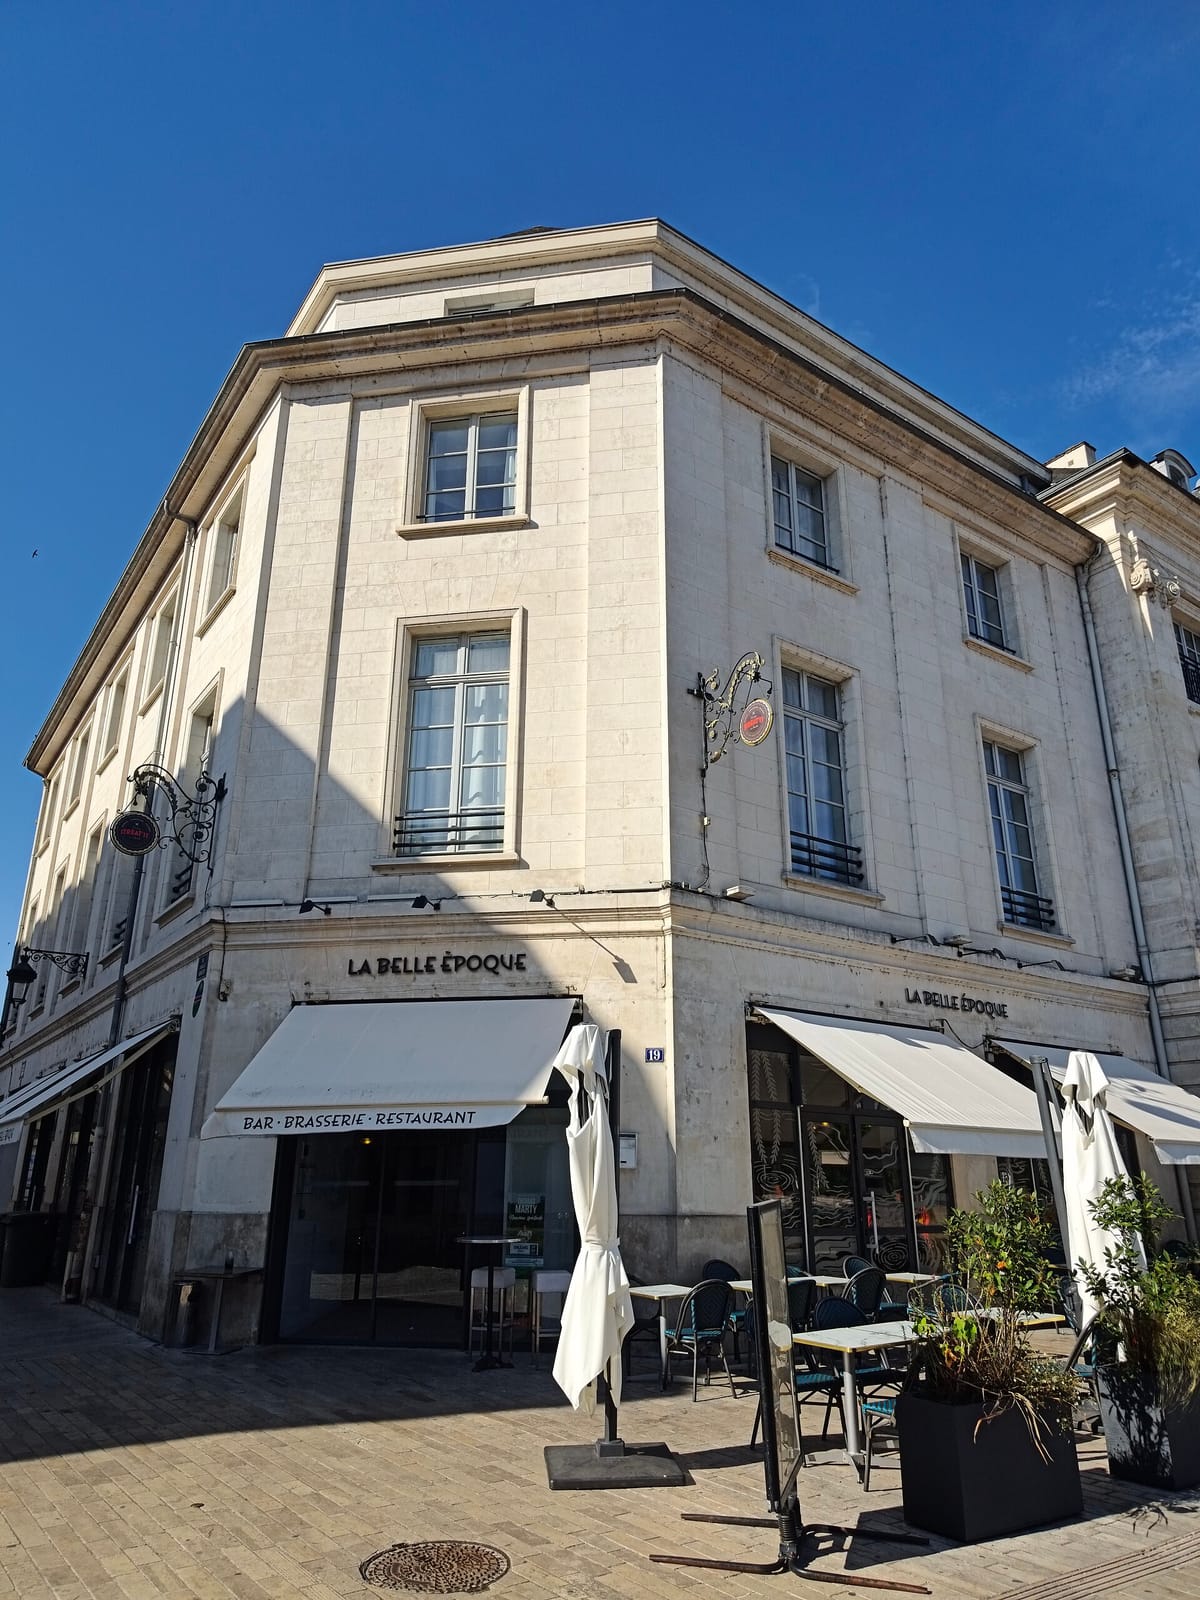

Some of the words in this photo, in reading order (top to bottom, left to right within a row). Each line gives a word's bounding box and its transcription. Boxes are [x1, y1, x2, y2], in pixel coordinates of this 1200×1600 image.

[348, 959, 372, 975] LA
[377, 956, 437, 974] BELLE
[440, 951, 527, 975] ÉPOQUE
[904, 987, 922, 1004] LA
[922, 990, 960, 1010] BELLE
[961, 993, 1009, 1019] ÉPOQUE
[648, 1049, 661, 1061] 19
[243, 1116, 273, 1130] BAR
[284, 1113, 366, 1128] BRASSERIE
[376, 1111, 476, 1125] RESTAURANT
